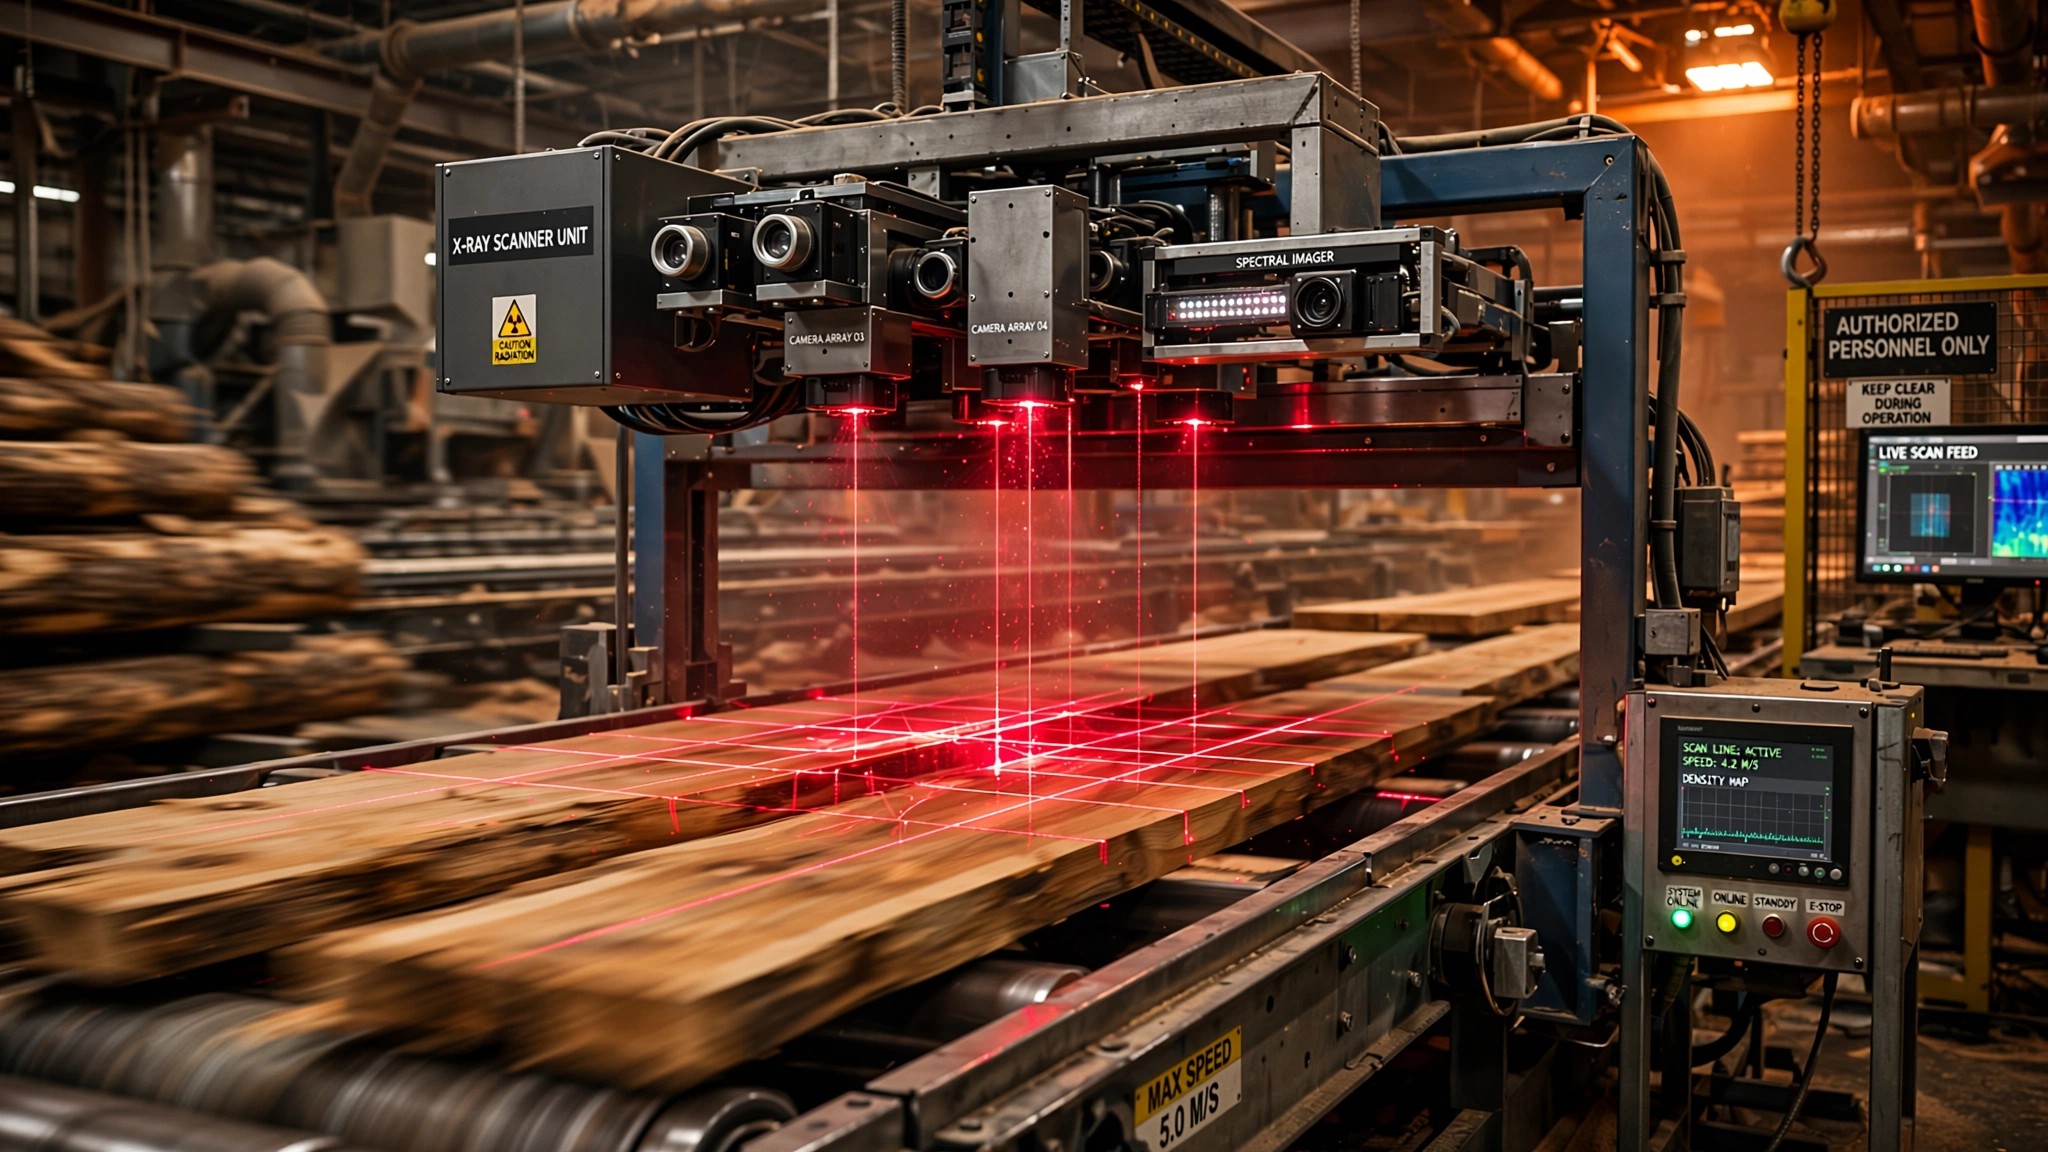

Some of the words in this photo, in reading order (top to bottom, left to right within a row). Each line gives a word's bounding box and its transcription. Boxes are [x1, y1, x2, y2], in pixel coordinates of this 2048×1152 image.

[453, 233, 490, 255] X-RAY
[493, 229, 554, 251] SCANNER
[557, 226, 589, 247] UNIT
[1236, 254, 1289, 269] SPECTRAL
[1292, 251, 1335, 265] IMAGER
[972, 323, 1006, 334] CAMERA
[1008, 321, 1036, 333] ARRAY
[1037, 321, 1048, 332] 04
[1836, 312, 1959, 336] AUTHORIZED
[499, 340, 531, 350] CAUTION
[789, 334, 824, 345] CAMERA
[825, 333, 853, 345] ARRAY
[853, 331, 865, 343] 03
[1829, 337, 1936, 359] PERSONNEL
[1941, 335, 1990, 356] ONLY
[1862, 384, 1891, 396] KEEP
[1895, 383, 1935, 395] CLEAR
[1875, 398, 1922, 410] DURING
[1862, 412, 1931, 424] OPERATION
[1879, 446, 1907, 460] LIVE
[1910, 446, 1943, 459] SCAN
[1946, 446, 1978, 459] FEED
[1683, 742, 1708, 753] SCAN
[1712, 744, 1741, 756] LINE:
[1745, 746, 1782, 758] ACTIVE
[1682, 756, 1717, 768] SPEED:
[1721, 758, 1738, 769] 4.2
[1741, 759, 1759, 771] M/S
[1682, 773, 1726, 786] DENSITY
[1729, 776, 1749, 787] MAP
[1713, 892, 1747, 906] ONLINE
[1809, 901, 1843, 913] E-STOP
[1147, 1067, 1182, 1114] MAX
[1186, 1038, 1232, 1088] SPEED
[1160, 1105, 1185, 1149] 5.0
[1190, 1082, 1219, 1128] M/S
